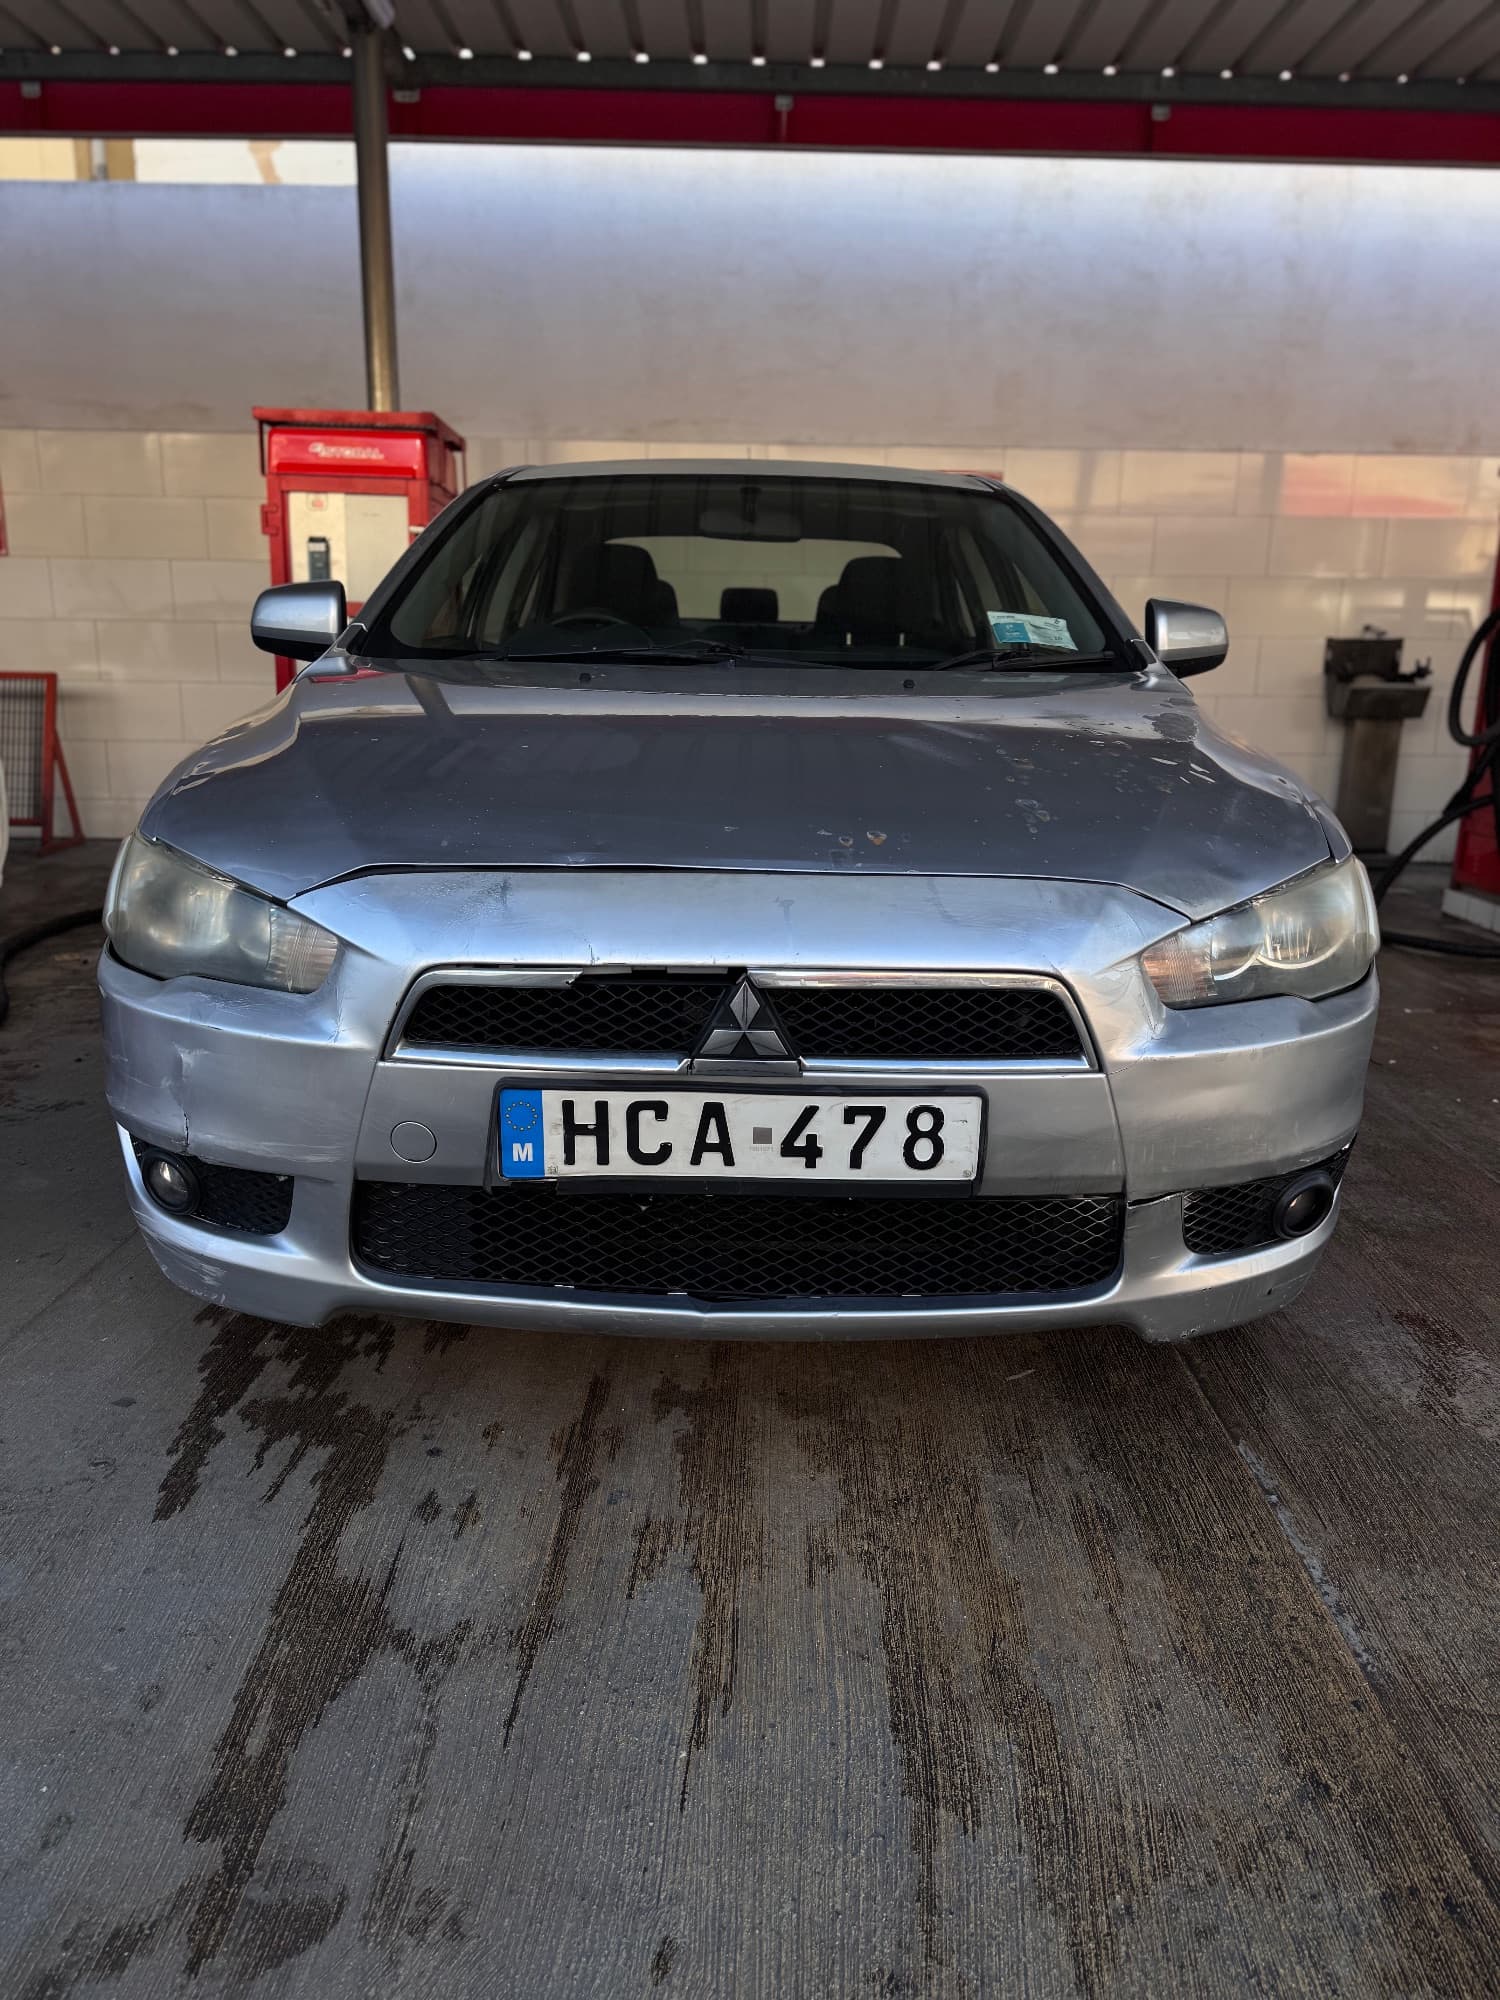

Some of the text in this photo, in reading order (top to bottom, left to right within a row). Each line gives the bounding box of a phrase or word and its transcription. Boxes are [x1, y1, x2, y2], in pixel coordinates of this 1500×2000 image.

[512, 1143, 533, 1162] M
[561, 1099, 945, 1171] HCA 478
